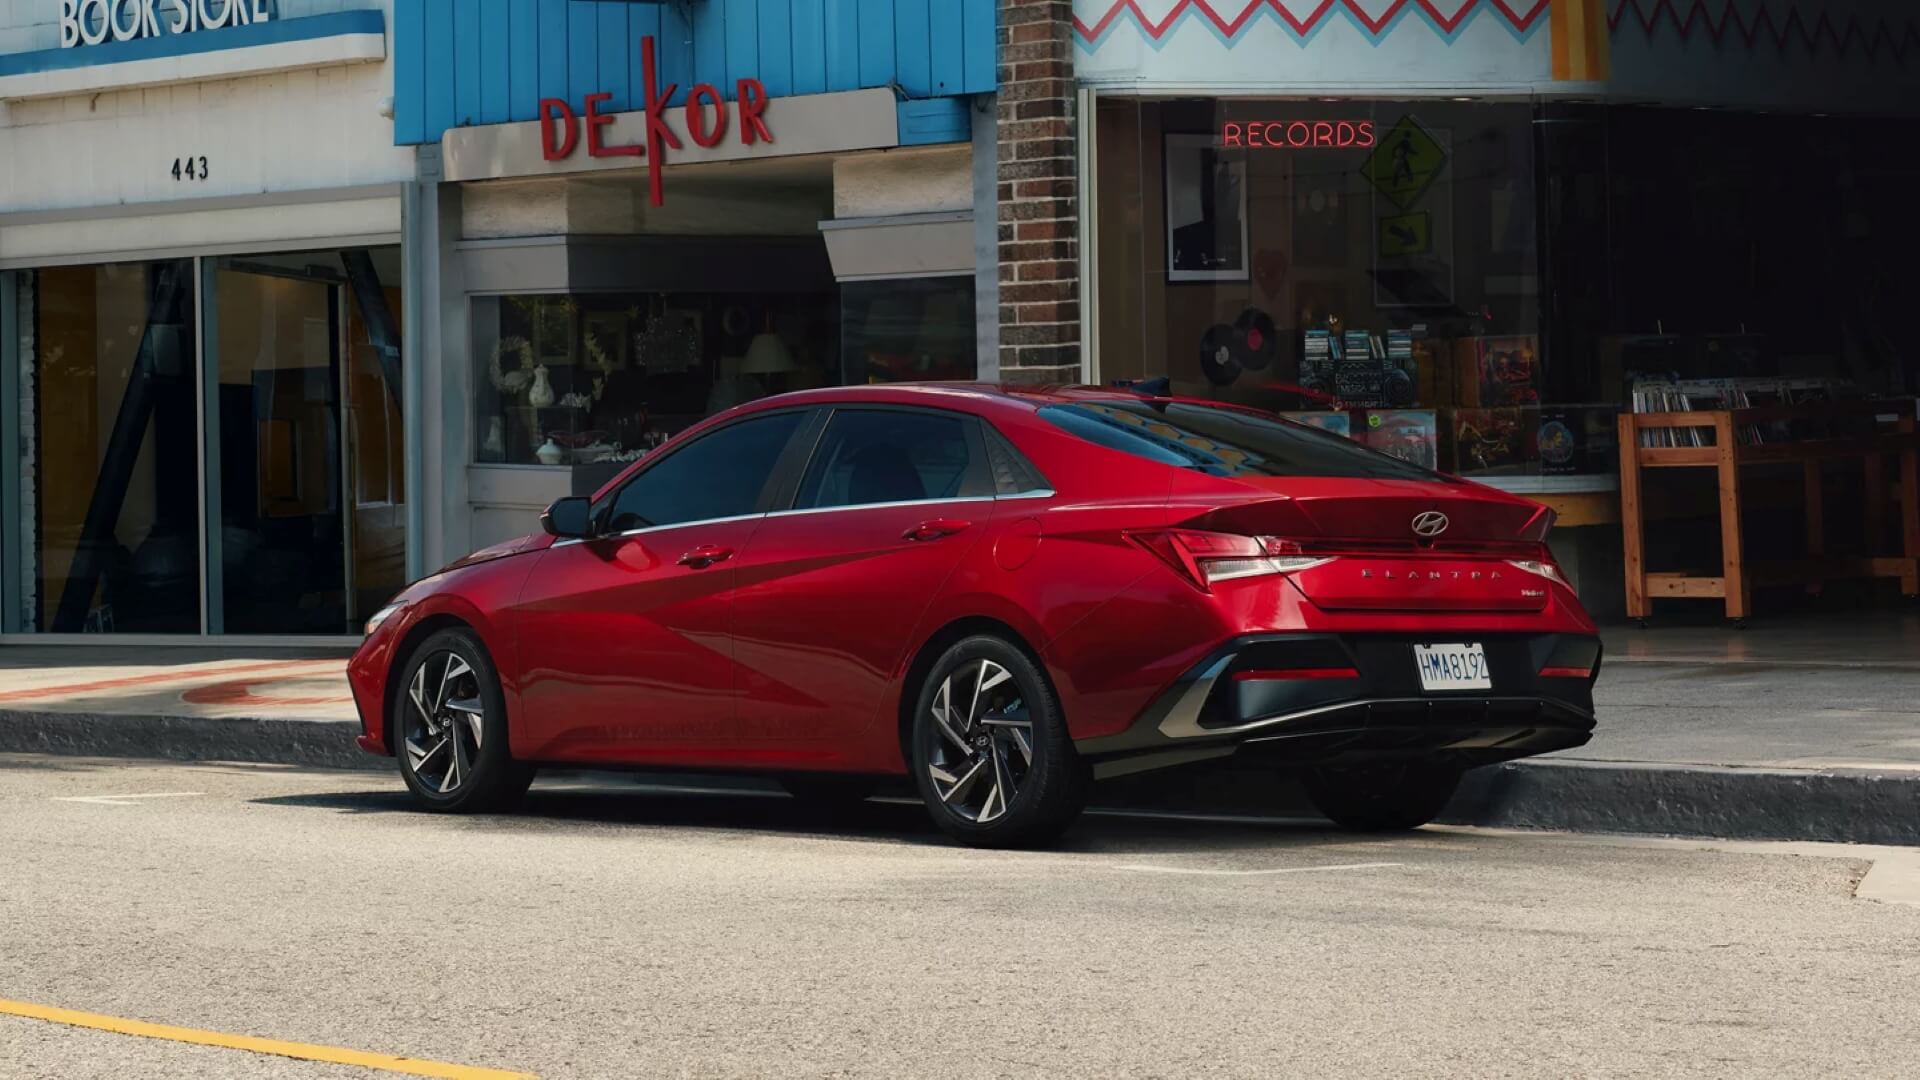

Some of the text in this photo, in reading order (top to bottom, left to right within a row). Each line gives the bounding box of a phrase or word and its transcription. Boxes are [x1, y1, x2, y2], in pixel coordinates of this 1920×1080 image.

[61, 0, 160, 48] BOOK
[540, 35, 774, 207] DEKOR
[1223, 121, 1376, 147] RECORDS
[171, 156, 209, 181] 443
[1361, 568, 1502, 579] ELANTRA
[1419, 652, 1490, 681] HMA8192
